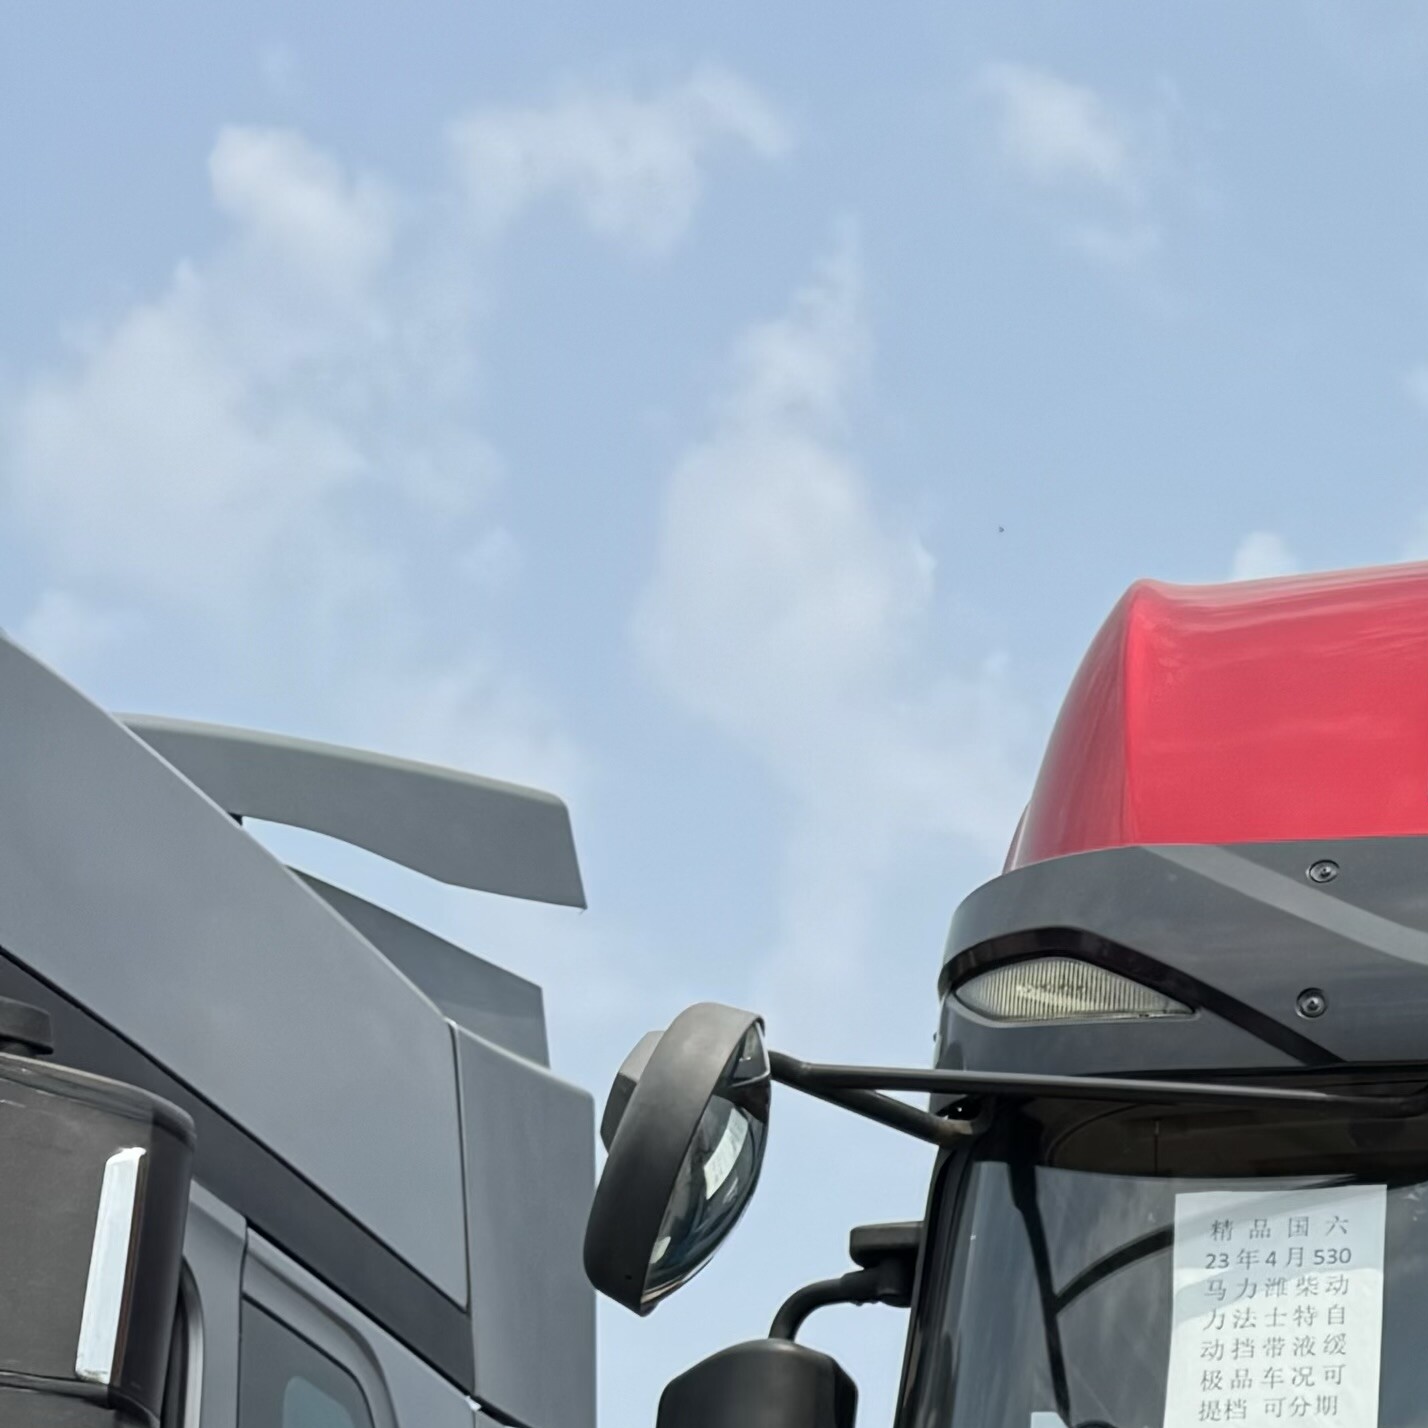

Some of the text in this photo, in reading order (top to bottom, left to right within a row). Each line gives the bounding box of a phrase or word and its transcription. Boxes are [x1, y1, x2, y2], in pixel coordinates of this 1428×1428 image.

[1209, 1215, 1350, 1242] 精品国六
[1203, 1273, 1350, 1301] 马力潍柴动
[1202, 1303, 1346, 1331] 力法士特自
[1199, 1363, 1346, 1392] 极品车况可
